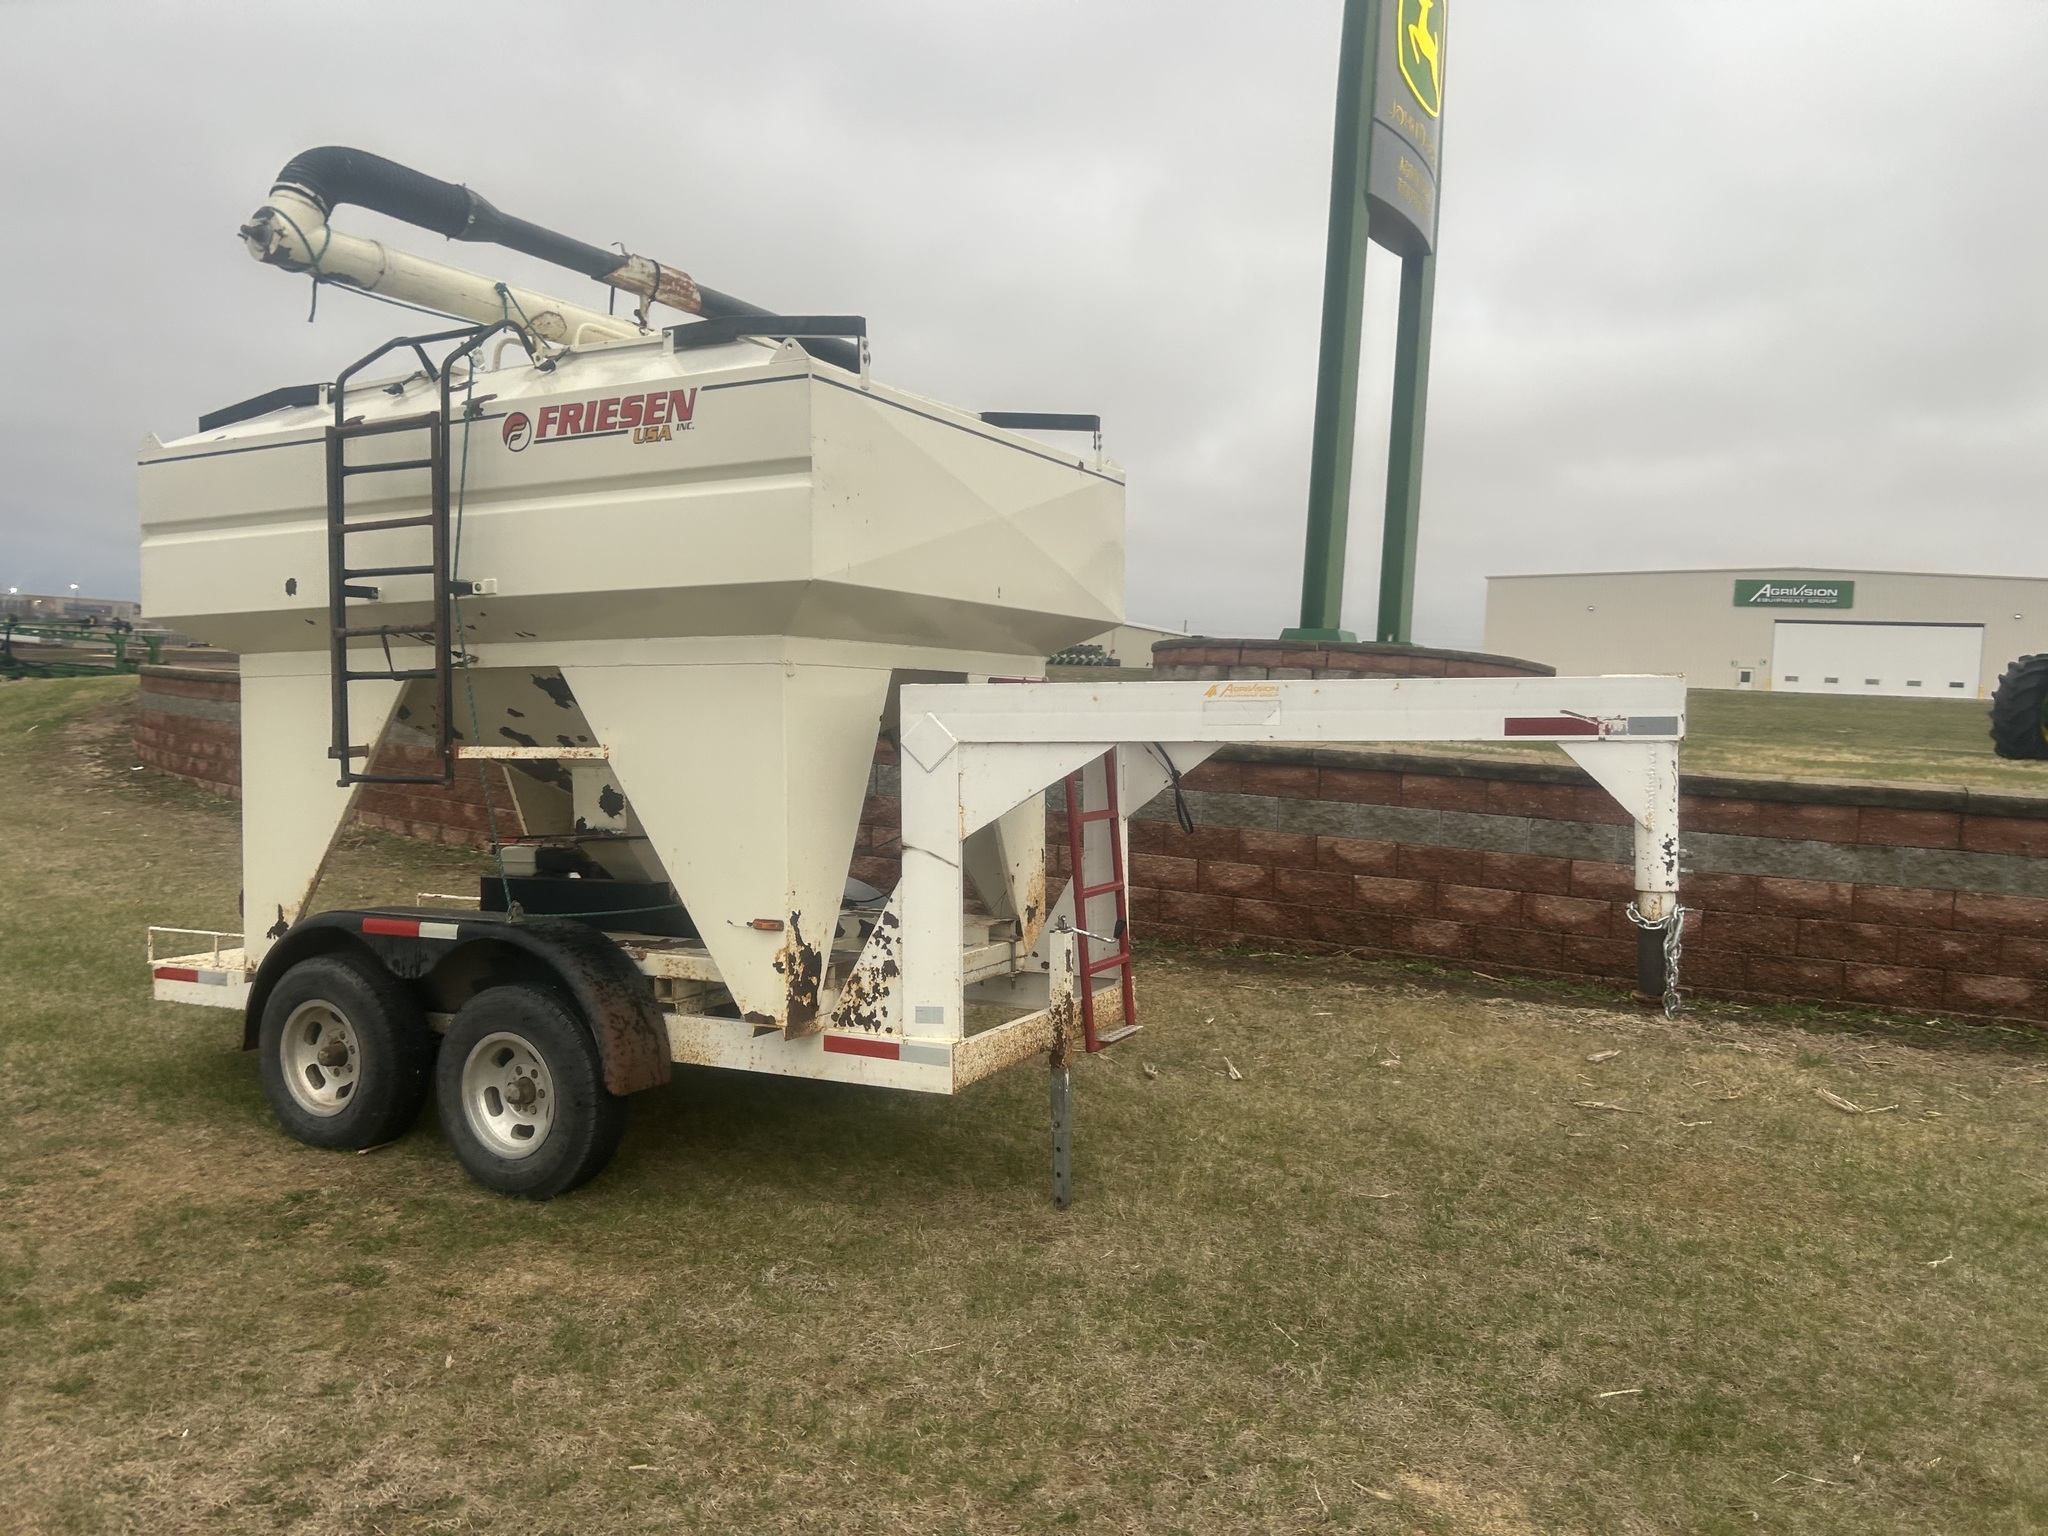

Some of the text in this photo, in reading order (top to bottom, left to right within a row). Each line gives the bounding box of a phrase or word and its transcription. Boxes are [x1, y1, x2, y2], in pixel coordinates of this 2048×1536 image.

[536, 387, 698, 439] FRIESEN
[633, 421, 695, 445] USA INC.
